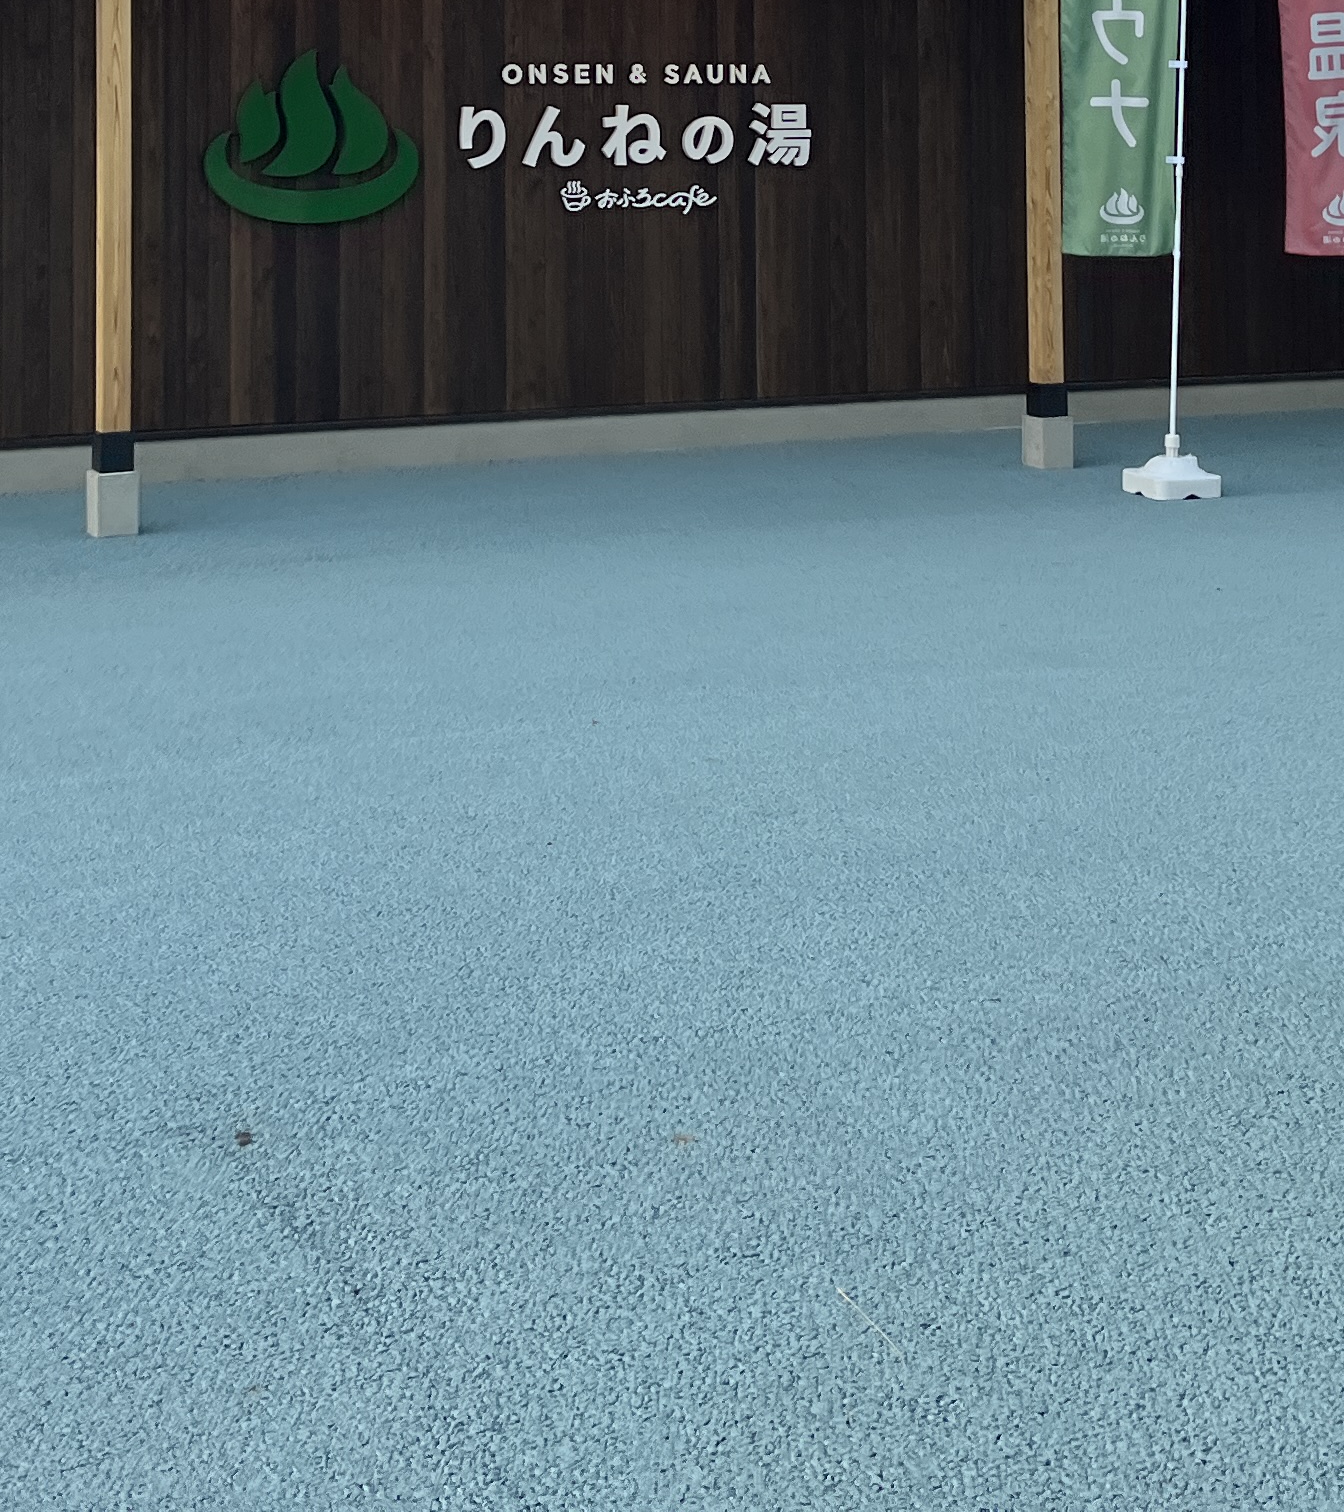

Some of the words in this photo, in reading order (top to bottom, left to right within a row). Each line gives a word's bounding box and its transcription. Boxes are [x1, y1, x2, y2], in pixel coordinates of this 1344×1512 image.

[501, 63, 615, 85] ONSEN
[628, 63, 647, 85] &
[663, 63, 772, 86] SAUNA
[458, 102, 812, 169] りんねの湯
